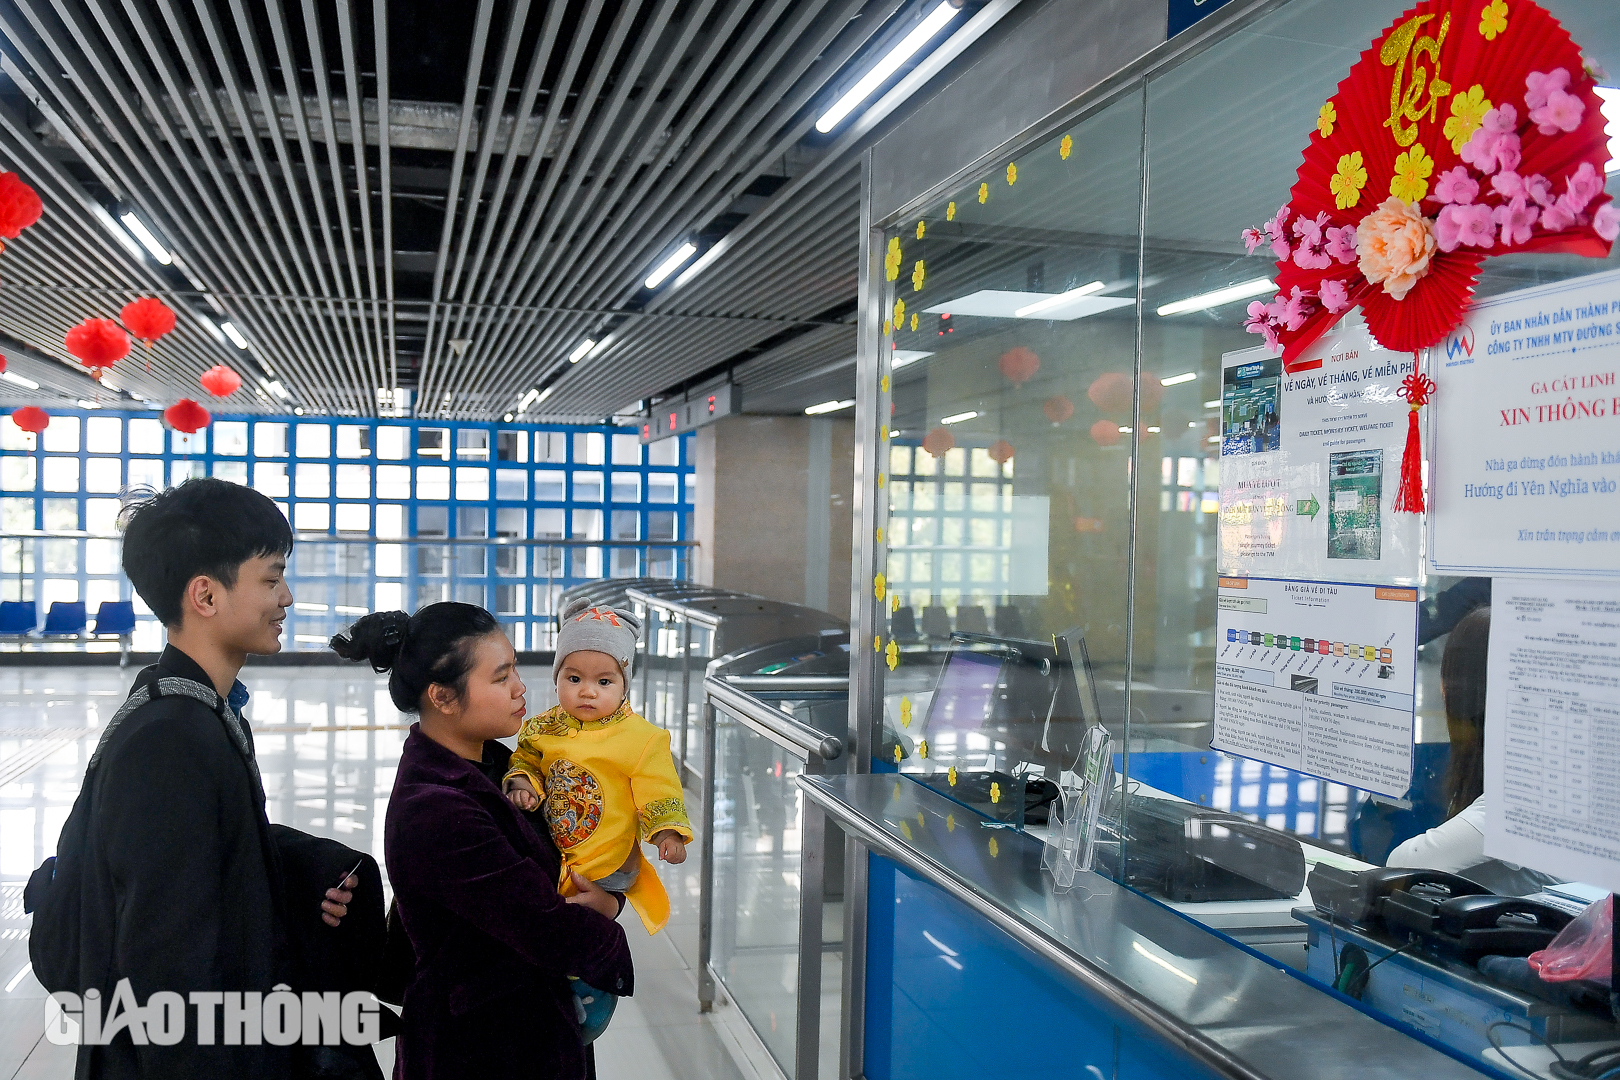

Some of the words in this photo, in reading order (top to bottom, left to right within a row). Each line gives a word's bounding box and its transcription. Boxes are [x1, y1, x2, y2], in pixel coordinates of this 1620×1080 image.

[1490, 320, 1501, 335] ỦY
[1504, 319, 1522, 333] BAN
[1525, 311, 1550, 329] NHÂN
[1553, 307, 1572, 324] DÂN
[1576, 301, 1608, 320] THÀNH
[1487, 339, 1511, 355] CÔNG
[1513, 338, 1523, 351] TY
[1526, 334, 1551, 349] TNHH
[1553, 330, 1574, 344] MTV
[1576, 322, 1613, 341] ĐƯỜNG
[1345, 350, 1359, 360] BÁN
[1284, 380, 1293, 392] VÉ
[1294, 376, 1316, 390] NGÀY,
[1317, 373, 1328, 387] VÉ
[1330, 369, 1360, 385] THÁNG,
[1362, 365, 1373, 380] VÉ
[1374, 360, 1398, 377] MIỄN
[1531, 382, 1548, 394] GA
[1551, 375, 1578, 392] CÁT
[1581, 372, 1615, 389] LINH
[1306, 395, 1314, 405] VÀ
[1500, 406, 1531, 427] XIN
[1535, 396, 1606, 423] THÔNG
[1485, 458, 1505, 471] Nhà
[1507, 460, 1518, 472] ga
[1547, 455, 1568, 468] đón
[1570, 452, 1598, 466] hành
[1464, 483, 1504, 500] Hướng
[1506, 481, 1518, 496] đi
[1521, 480, 1545, 496] Yên
[1549, 478, 1589, 498] Nghĩa
[1592, 477, 1617, 493] vào
[1518, 529, 1534, 541] Xin
[1311, 584, 1318, 594] VÉ
[1327, 586, 1338, 595] TÀU
